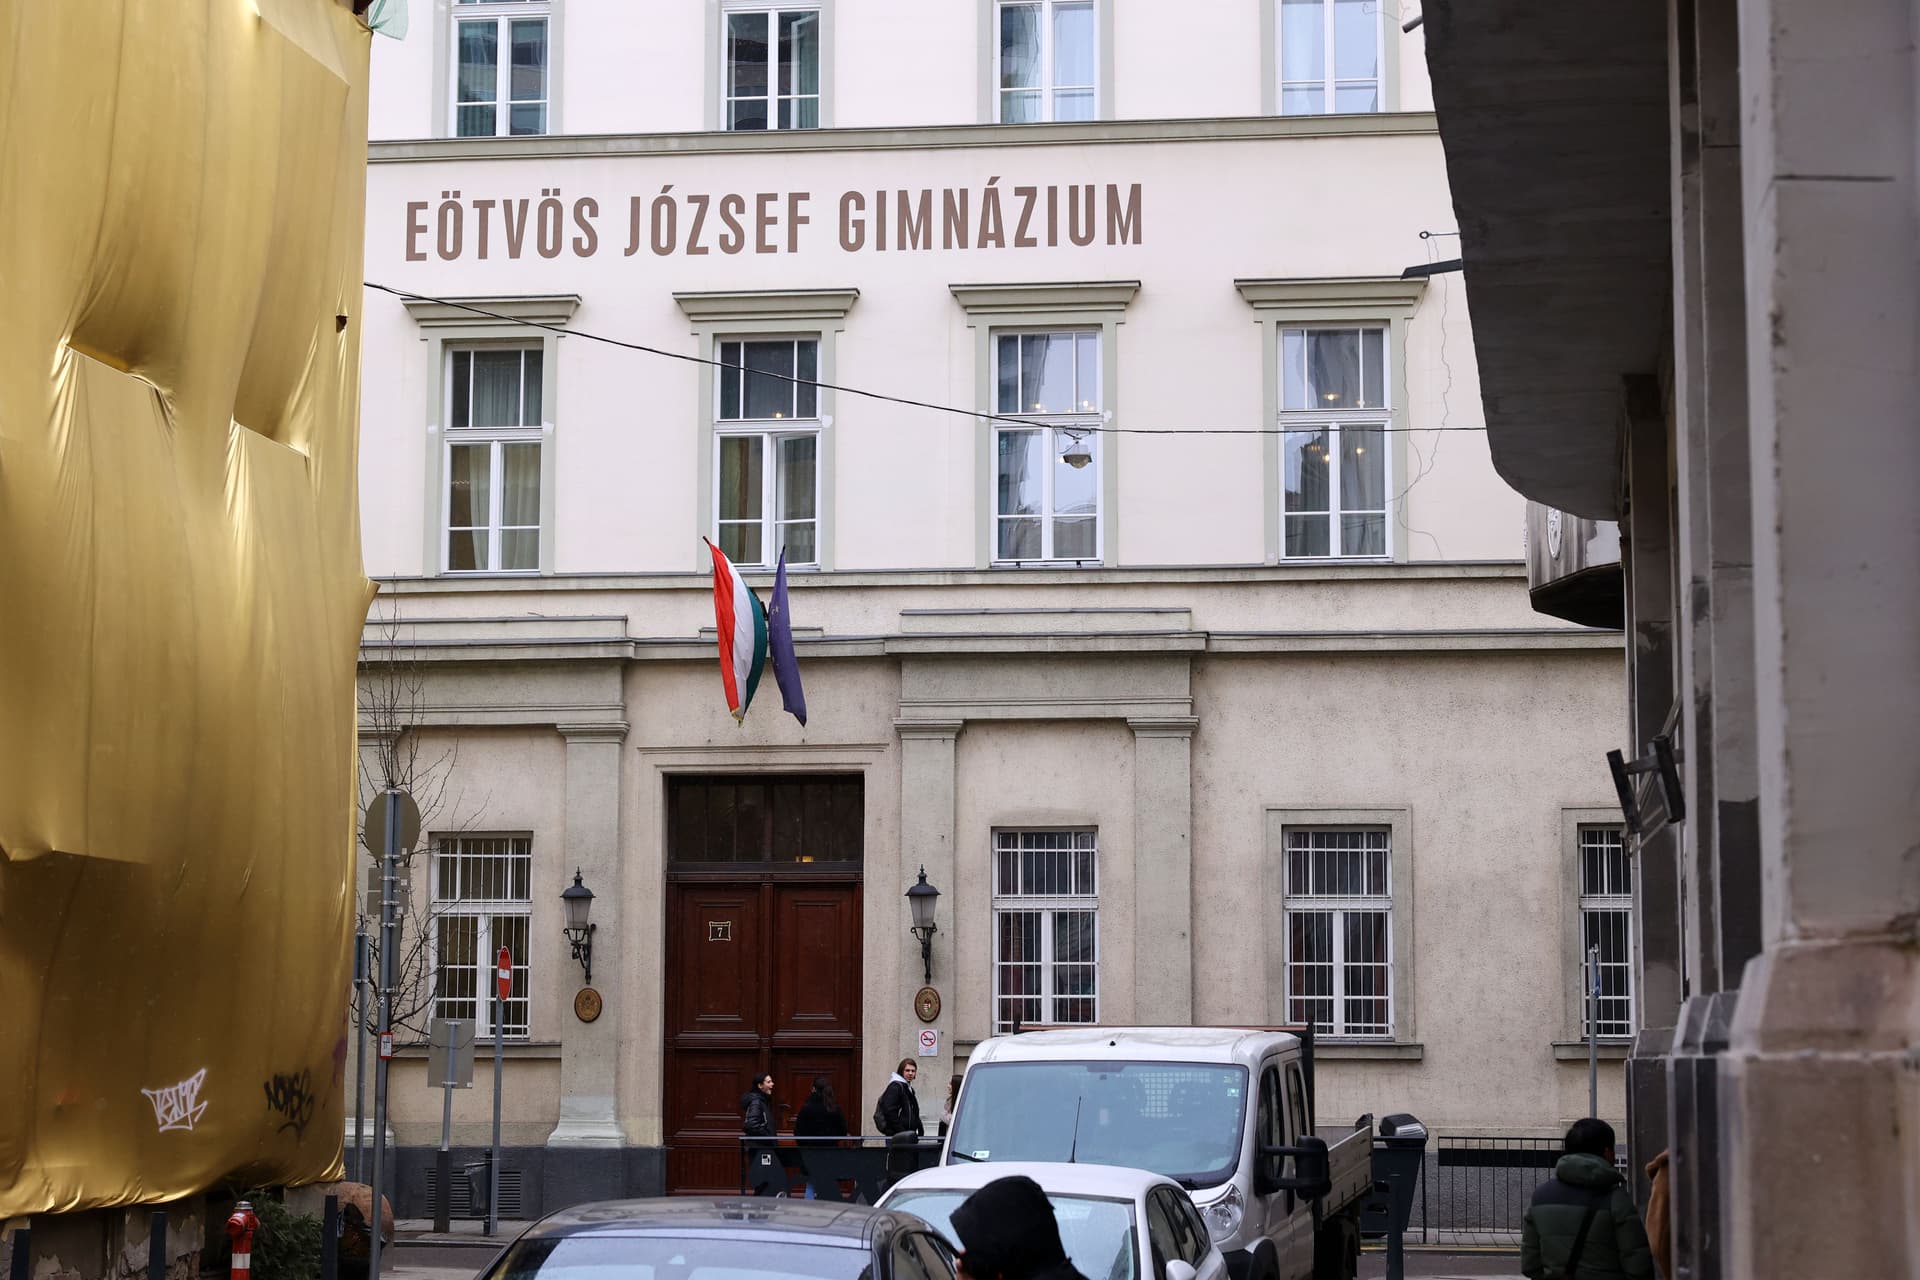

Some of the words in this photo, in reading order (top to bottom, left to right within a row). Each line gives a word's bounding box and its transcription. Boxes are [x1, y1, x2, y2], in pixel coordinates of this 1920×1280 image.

[406, 188, 599, 261] EÖTVÖS
[624, 185, 810, 257] JÓZSEF
[839, 176, 1142, 252] GIMNÁZIUM
[717, 927, 723, 938] 7
